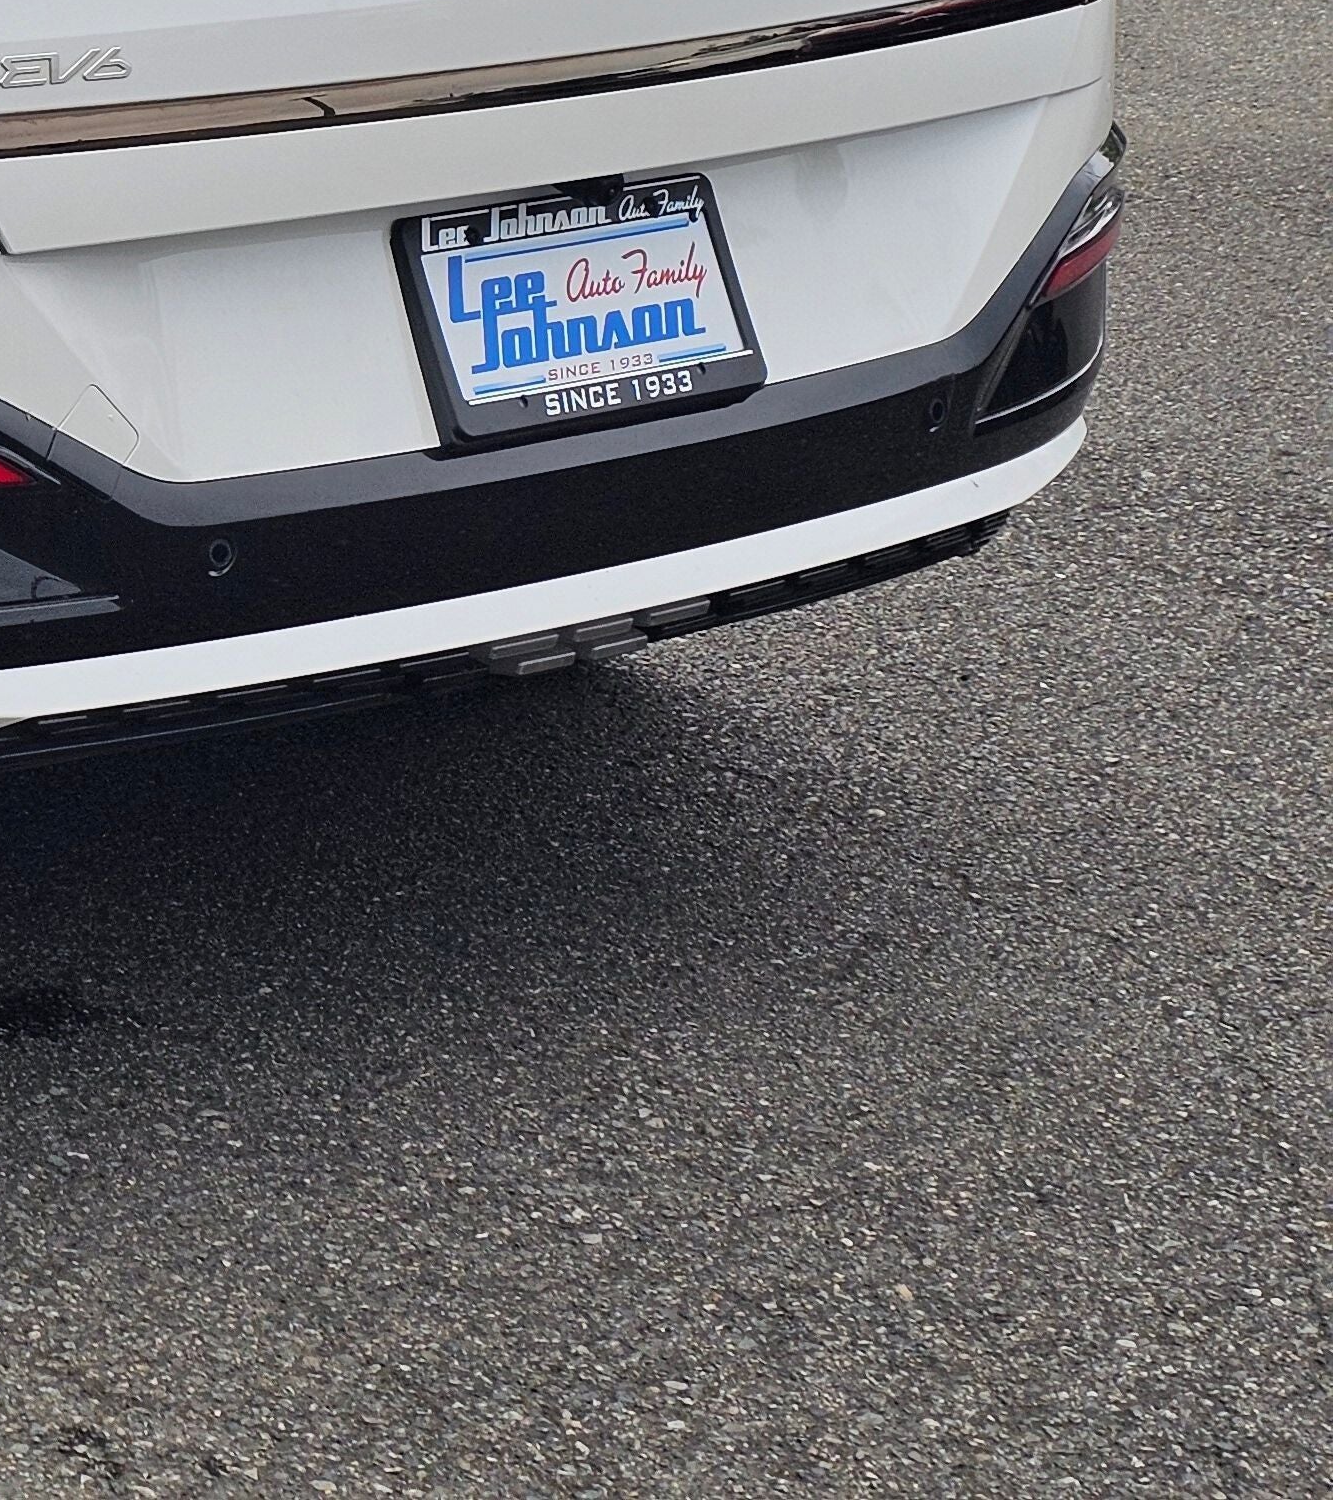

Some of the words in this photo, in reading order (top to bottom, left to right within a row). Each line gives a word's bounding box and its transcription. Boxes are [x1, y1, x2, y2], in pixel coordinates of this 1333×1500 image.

[0, 46, 132, 89] EV6
[484, 203, 611, 243] Johnson
[619, 194, 652, 221] Aut
[652, 185, 705, 218] Family
[448, 255, 557, 323] Lee
[566, 257, 626, 303] Auto
[621, 241, 708, 299] Family
[471, 295, 706, 375] Johnson
[545, 383, 621, 416] SINCE
[632, 370, 693, 401] 1933
[548, 362, 600, 381] SINCE
[610, 353, 654, 372] 1933
